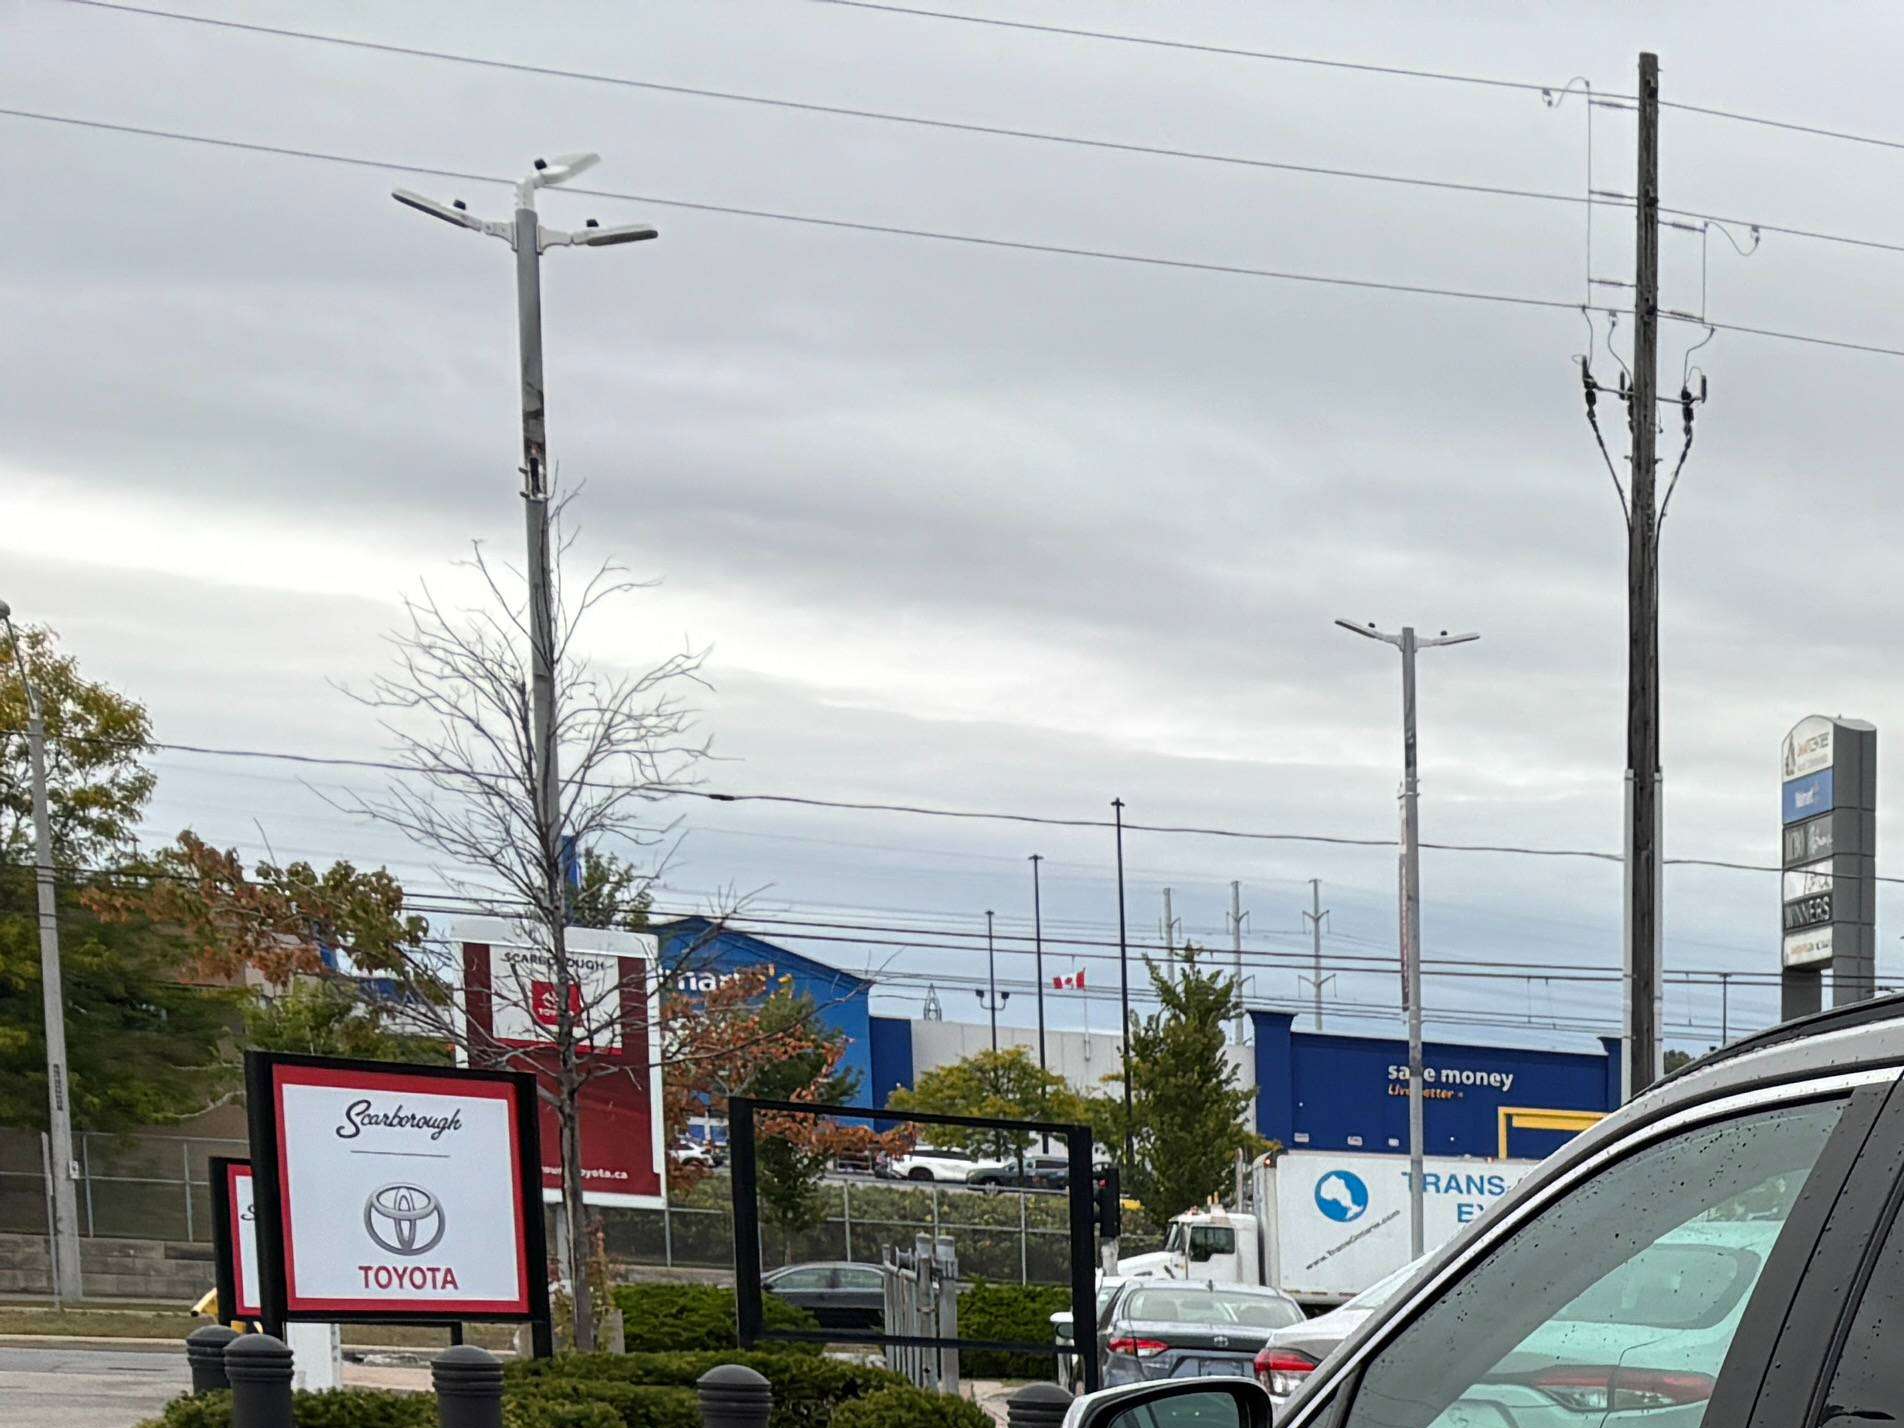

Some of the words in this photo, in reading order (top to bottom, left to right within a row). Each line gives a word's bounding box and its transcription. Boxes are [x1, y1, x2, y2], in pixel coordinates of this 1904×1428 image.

[504, 952, 605, 970] SCARBOOUGH
[1388, 1065, 1436, 1082] sae
[1440, 1068, 1514, 1092] money
[1423, 1088, 1454, 1099] etter
[336, 1099, 462, 1140] Scarborough
[358, 1266, 459, 1290] TOYOTA
